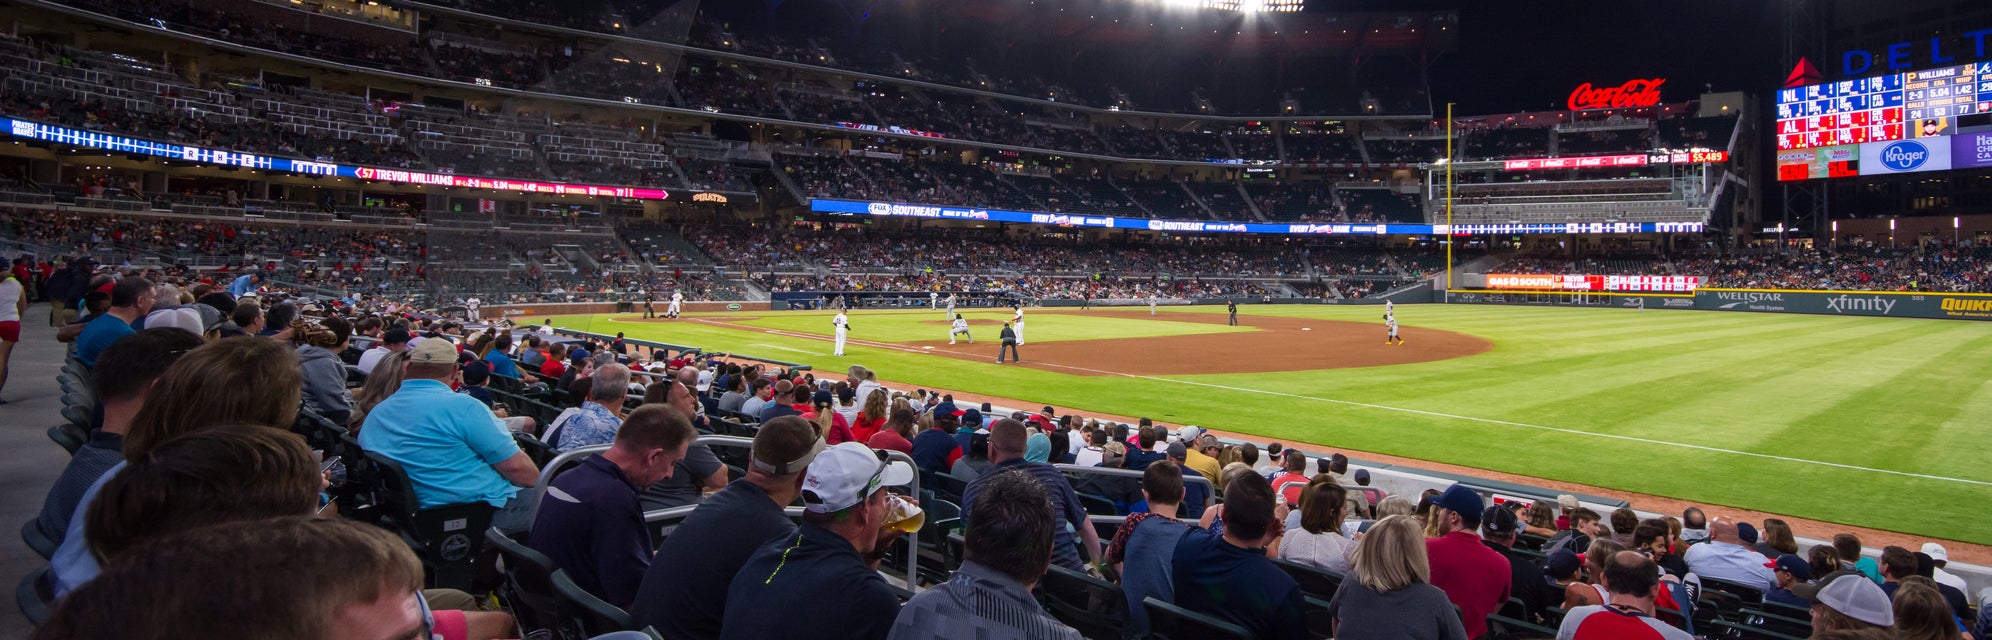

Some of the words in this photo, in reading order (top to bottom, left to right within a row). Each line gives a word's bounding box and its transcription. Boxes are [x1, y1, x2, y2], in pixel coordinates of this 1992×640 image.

[1843, 29, 1992, 76] DELT
[1919, 68, 1955, 80] WILLIAMS
[1906, 82, 1928, 90] RECORD
[1956, 85, 1972, 94] 1.42
[1568, 78, 1666, 111] Coca-Cola
[1783, 90, 1798, 102] NL
[1909, 91, 1924, 100] 2-3
[1930, 88, 1949, 98] 5.04
[1911, 110, 1922, 118] 24
[1935, 108, 1946, 116] 53
[1959, 105, 1970, 114] 77
[12, 120, 34, 130] PIRATES
[1784, 121, 1798, 134] AL
[13, 128, 34, 138] BRAVES
[1692, 152, 1722, 162] $5,489
[1886, 146, 1924, 168] Kroger
[362, 170, 374, 178] 57
[376, 170, 408, 182] TREVOR
[410, 172, 453, 186] WILLIAMS
[494, 181, 508, 189] 5.04
[524, 183, 536, 191] 1.42
[589, 187, 598, 195] 53
[892, 205, 941, 217] SOUTHEAST
[1032, 214, 1049, 223] EVERY
[1164, 222, 1204, 230] SOUTHEAST
[1520, 278, 1552, 286] SOUTH
[1717, 292, 1783, 302] WELLSTAR
[1827, 294, 1896, 314] xfinity
